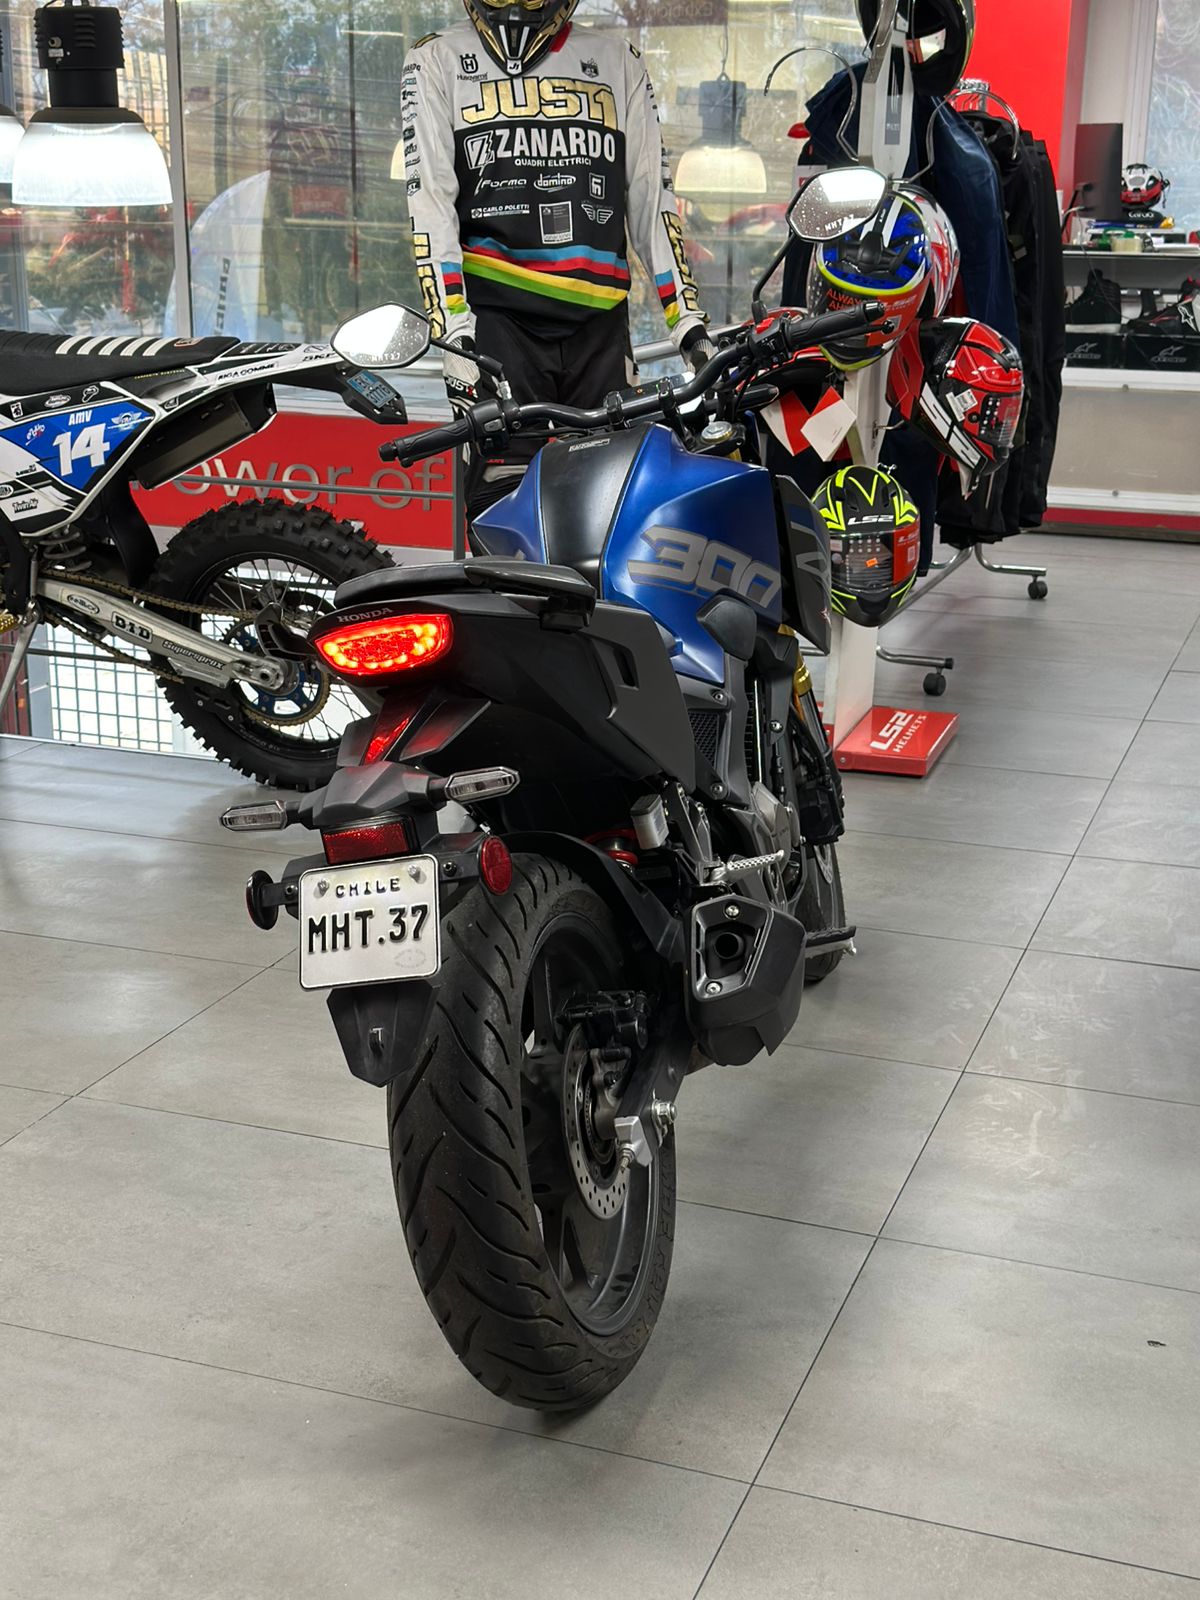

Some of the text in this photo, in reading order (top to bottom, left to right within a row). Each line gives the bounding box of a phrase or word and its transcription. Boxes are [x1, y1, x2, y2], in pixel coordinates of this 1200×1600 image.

[461, 76, 618, 131] JUST1
[495, 127, 616, 163] ZANARDO
[514, 157, 592, 167] QUADRI ELETTRICI
[537, 173, 573, 187] domino
[482, 203, 530, 213] CARLO POLETTI
[53, 423, 110, 476] 14
[131, 457, 445, 511] ower of
[847, 514, 894, 526] LS2
[627, 525, 782, 608] 300
[337, 607, 393, 622] HONDA
[162, 640, 225, 671] Supersprox
[869, 711, 914, 751] LS2
[892, 713, 928, 753] HELMETS
[335, 877, 401, 899] CHILE
[308, 904, 429, 954] MHT.37
